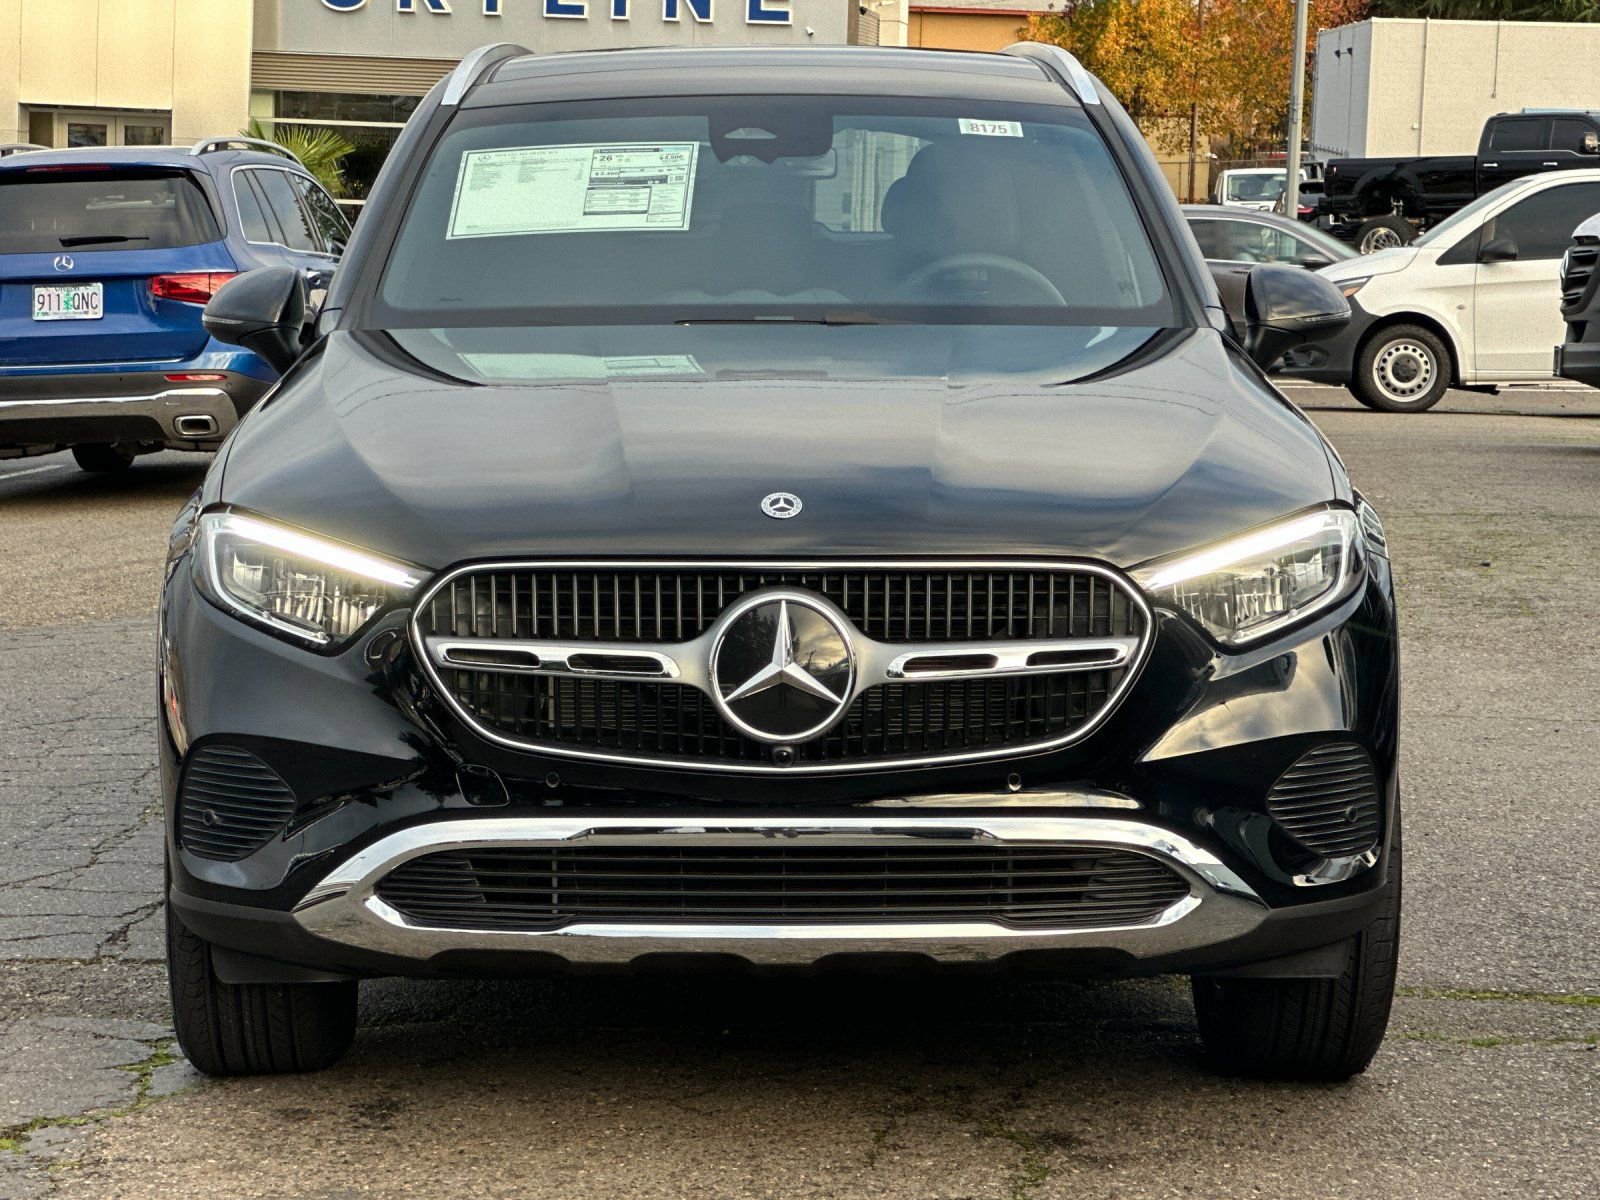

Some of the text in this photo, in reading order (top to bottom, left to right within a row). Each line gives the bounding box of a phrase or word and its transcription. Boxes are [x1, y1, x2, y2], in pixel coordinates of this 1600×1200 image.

[970, 122, 1008, 134] 8175
[37, 292, 98, 311] 911 QNC
